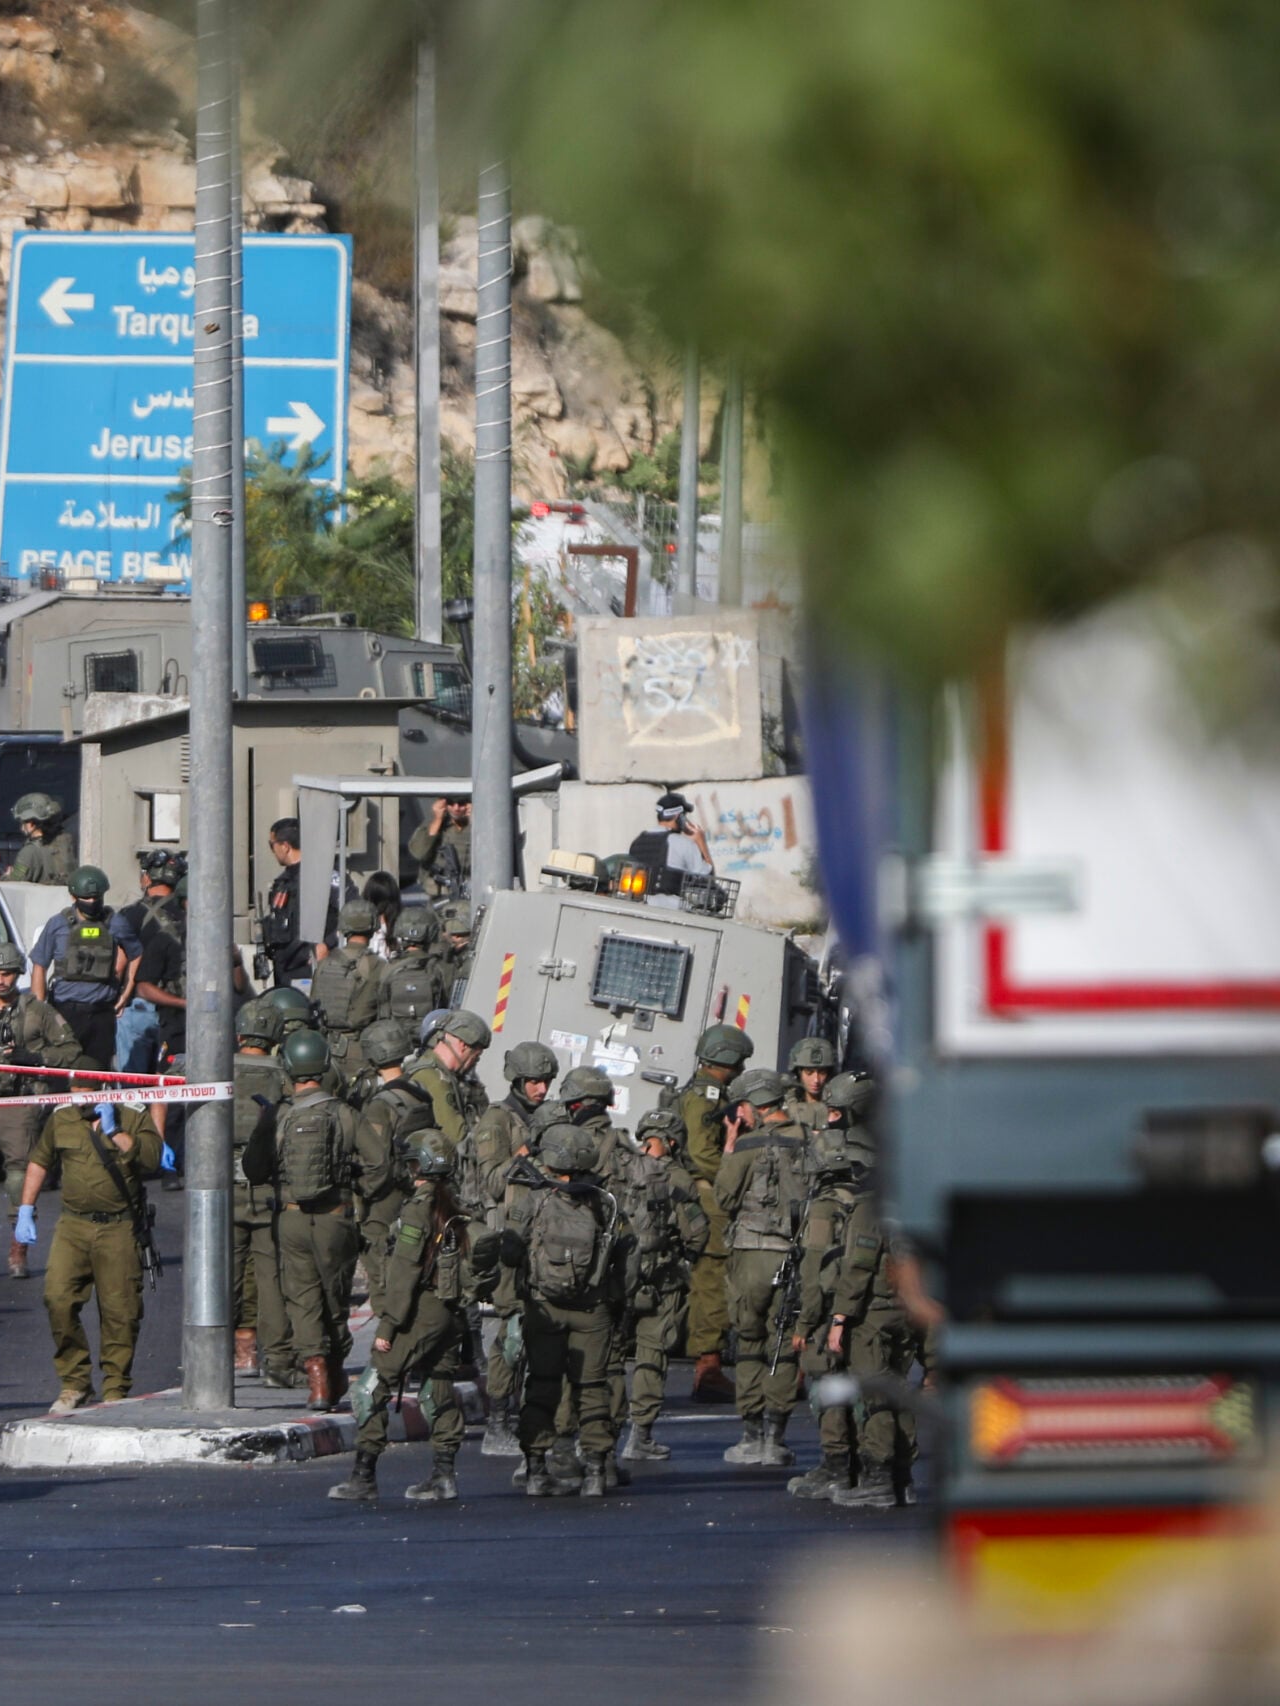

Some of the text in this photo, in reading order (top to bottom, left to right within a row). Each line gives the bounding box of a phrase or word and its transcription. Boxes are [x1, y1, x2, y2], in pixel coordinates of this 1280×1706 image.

[113, 304, 259, 345] Tarqua
[57, 499, 161, 530] السلامة
[20, 549, 112, 577] PEACE
[122, 551, 161, 577] BE
[138, 1088, 167, 1100] ישראל
[181, 1085, 216, 1098] משטרת
